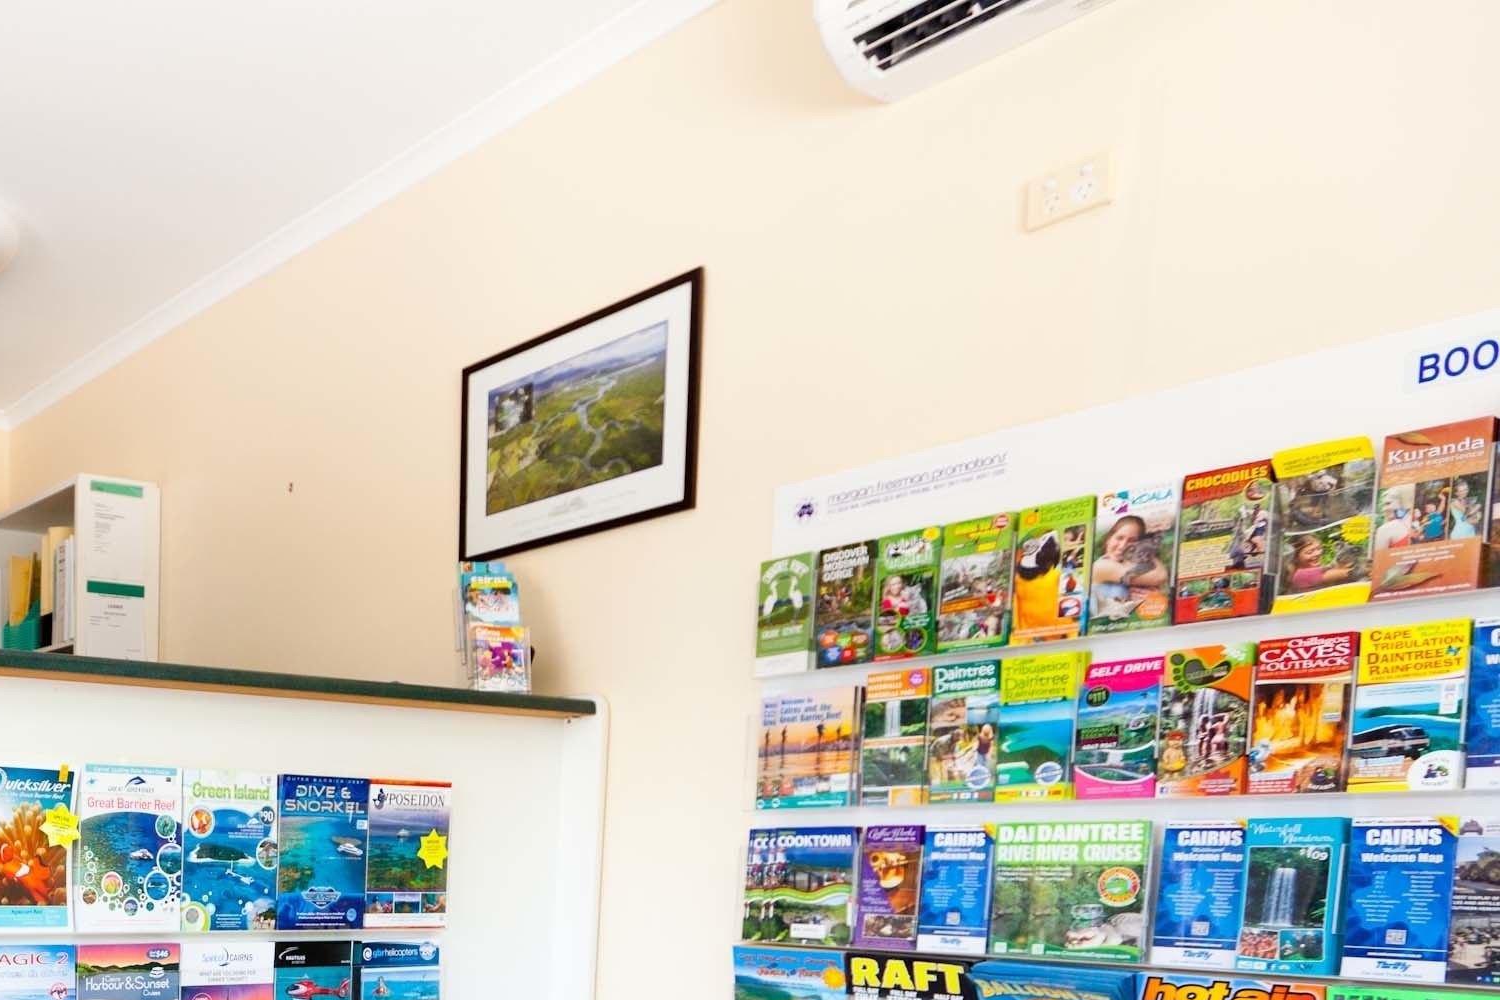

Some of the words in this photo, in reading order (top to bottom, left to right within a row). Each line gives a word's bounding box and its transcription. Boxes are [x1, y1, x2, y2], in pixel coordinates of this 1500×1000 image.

[1387, 437, 1485, 465] Kuranda
[1186, 465, 1269, 492] CROCODILES
[1369, 630, 1412, 643] CAPE
[1372, 635, 1465, 651] TRIBULATION
[1260, 643, 1350, 663] CAVES
[1367, 649, 1444, 665] DAINTREE
[934, 664, 996, 680] Daintree
[1089, 666, 1122, 679] SELF
[1124, 660, 1162, 674] DRIVE
[1266, 656, 1350, 672] OUTBACK
[1368, 657, 1463, 675] RAINFOREST
[1005, 672, 1070, 691] Daintree
[192, 783, 232, 800] Green
[234, 784, 271, 801] Island
[295, 785, 336, 797] DIVE
[88, 797, 115, 809] Great
[117, 798, 152, 810] Barrier
[154, 799, 175, 810] Reef
[284, 799, 365, 814] SNORKEL
[388, 794, 445, 808] POSEIDON
[777, 833, 851, 847] COOKTOWN
[933, 833, 986, 847] CAIRNS
[1037, 823, 1144, 842] DAINTREE
[1177, 830, 1243, 847] CAIRNS
[1365, 829, 1442, 846] CAIRNS
[930, 852, 966, 861] Welcome
[968, 852, 986, 861] Map
[1036, 844, 1079, 862] RIVER
[1084, 843, 1142, 862] CRUISES
[1173, 852, 1218, 862] Welcome
[1220, 853, 1243, 862] Map
[1361, 853, 1416, 863] Welcome
[1418, 853, 1444, 864] Map
[57, 952, 69, 965] 2
[230, 953, 253, 962] CAIRNS
[1182, 949, 1213, 960] Thrifty
[1375, 960, 1411, 972] Thrifty
[851, 957, 964, 994] RAFT
